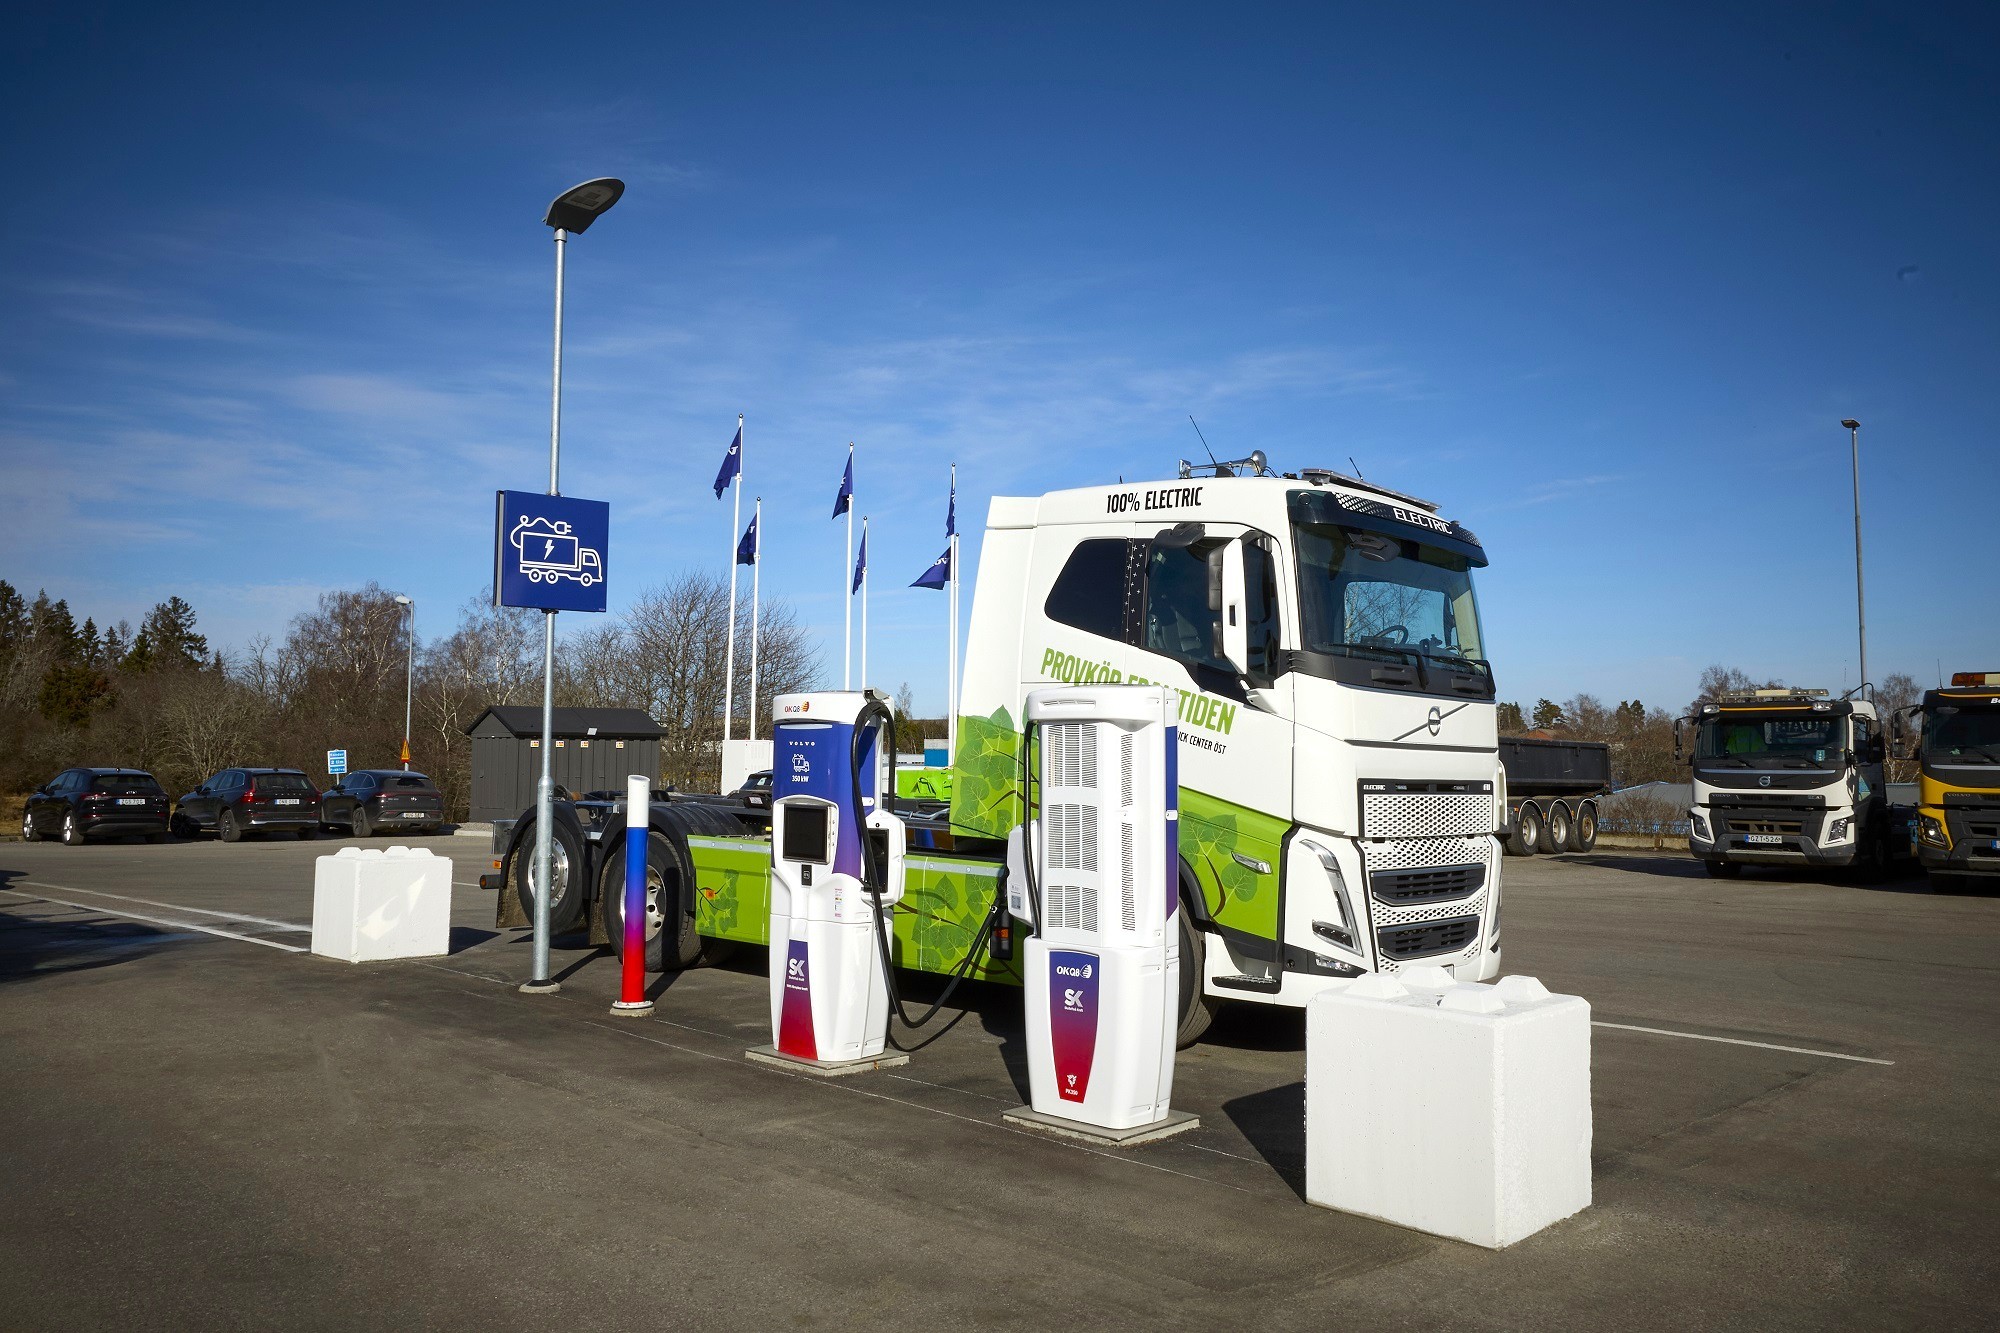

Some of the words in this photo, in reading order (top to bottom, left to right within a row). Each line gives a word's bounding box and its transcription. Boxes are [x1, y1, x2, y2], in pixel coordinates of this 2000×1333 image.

[1107, 492, 1140, 514] 100%
[1145, 486, 1203, 510] ELECTRIC
[1393, 507, 1453, 535] ELECTRIC
[1189, 735, 1213, 751] CENTER
[1213, 740, 1227, 755] ÖST
[788, 958, 805, 977] SK
[1064, 988, 1084, 1008] SK
